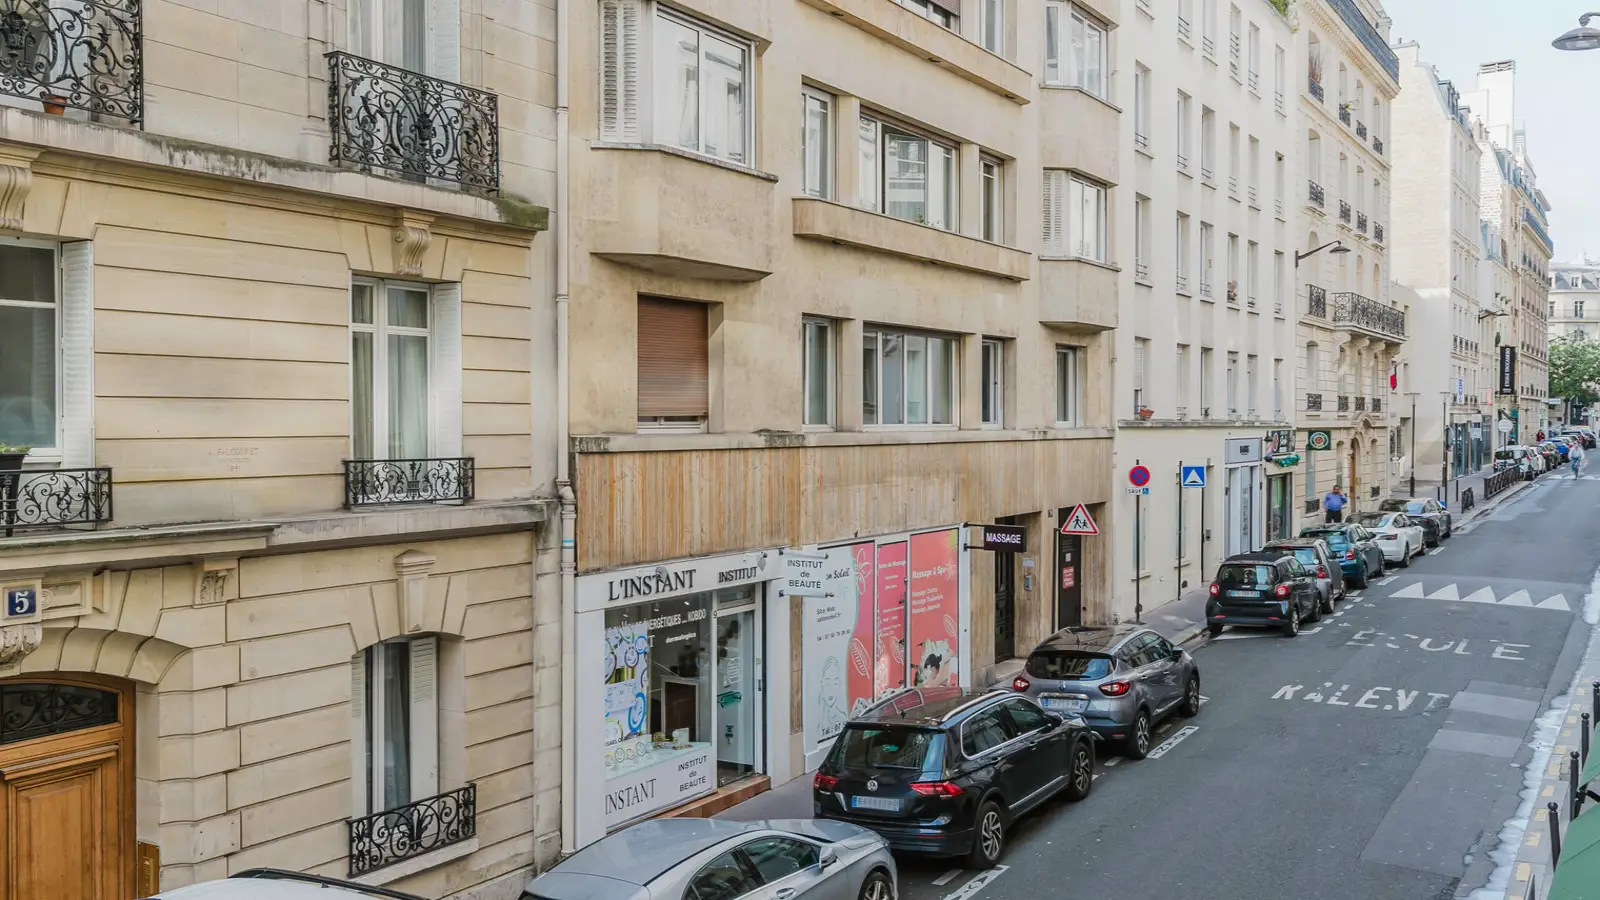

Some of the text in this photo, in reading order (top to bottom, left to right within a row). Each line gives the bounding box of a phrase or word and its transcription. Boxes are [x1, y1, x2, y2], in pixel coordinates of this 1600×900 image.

[986, 532, 1022, 544] MASSAGE
[787, 559, 823, 569] INSTITUT
[718, 566, 758, 583] INSTITUT
[800, 569, 810, 578] de
[911, 569, 932, 579] Massage
[608, 568, 697, 602] L'INSTANT
[788, 579, 822, 589] BEAUTÉ
[14, 591, 29, 614] 5
[677, 755, 708, 772] INSTITUT
[688, 770, 698, 778] de
